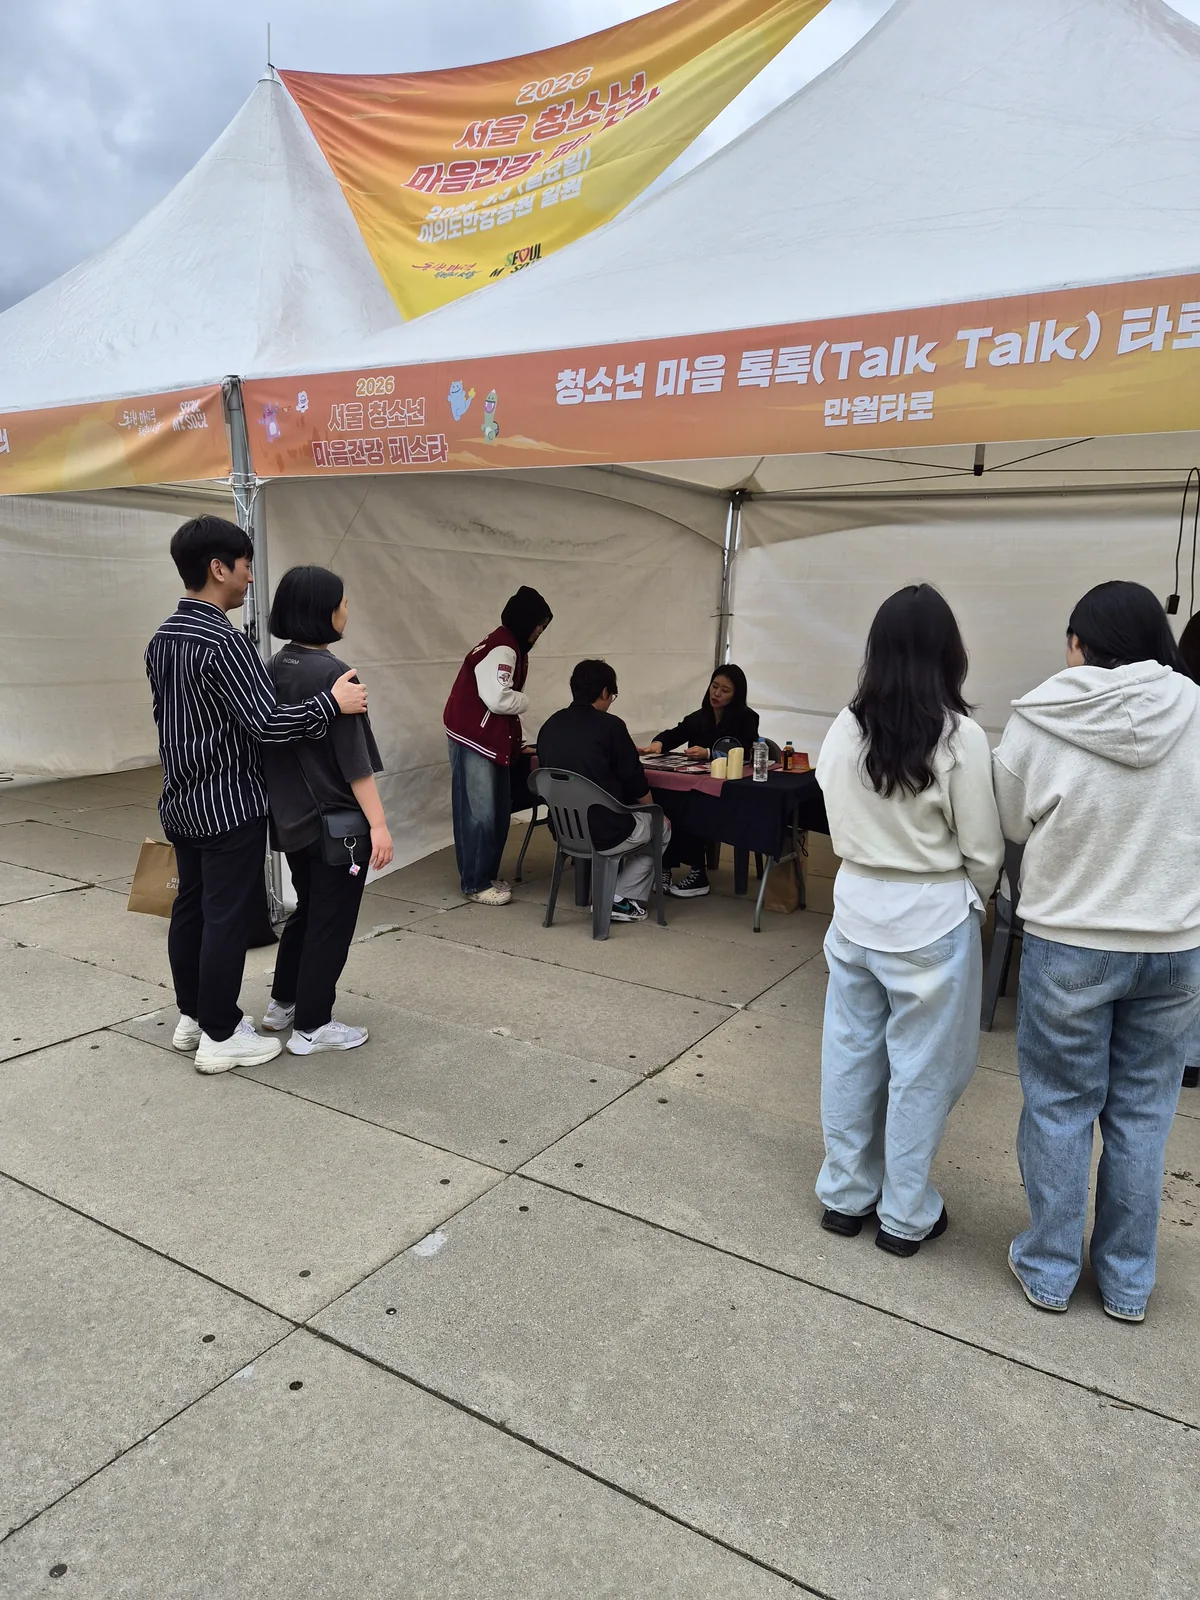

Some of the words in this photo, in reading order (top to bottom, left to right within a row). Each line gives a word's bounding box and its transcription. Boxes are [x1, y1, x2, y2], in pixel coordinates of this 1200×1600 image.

[516, 67, 594, 106] 2026
[453, 114, 528, 150] 서울
[531, 71, 646, 142] 청소년
[401, 150, 545, 195] 마음건강
[555, 362, 647, 405] 청소년
[655, 354, 726, 397] 마음
[737, 340, 939, 388] 톡톡(Talk
[956, 310, 1101, 369] Talk)
[356, 375, 396, 397] 2026
[327, 402, 364, 432] 서울
[368, 396, 425, 430] 청소년
[824, 390, 935, 427] 만월타로
[312, 437, 385, 468] 마음건강
[387, 433, 449, 465] 페스타
